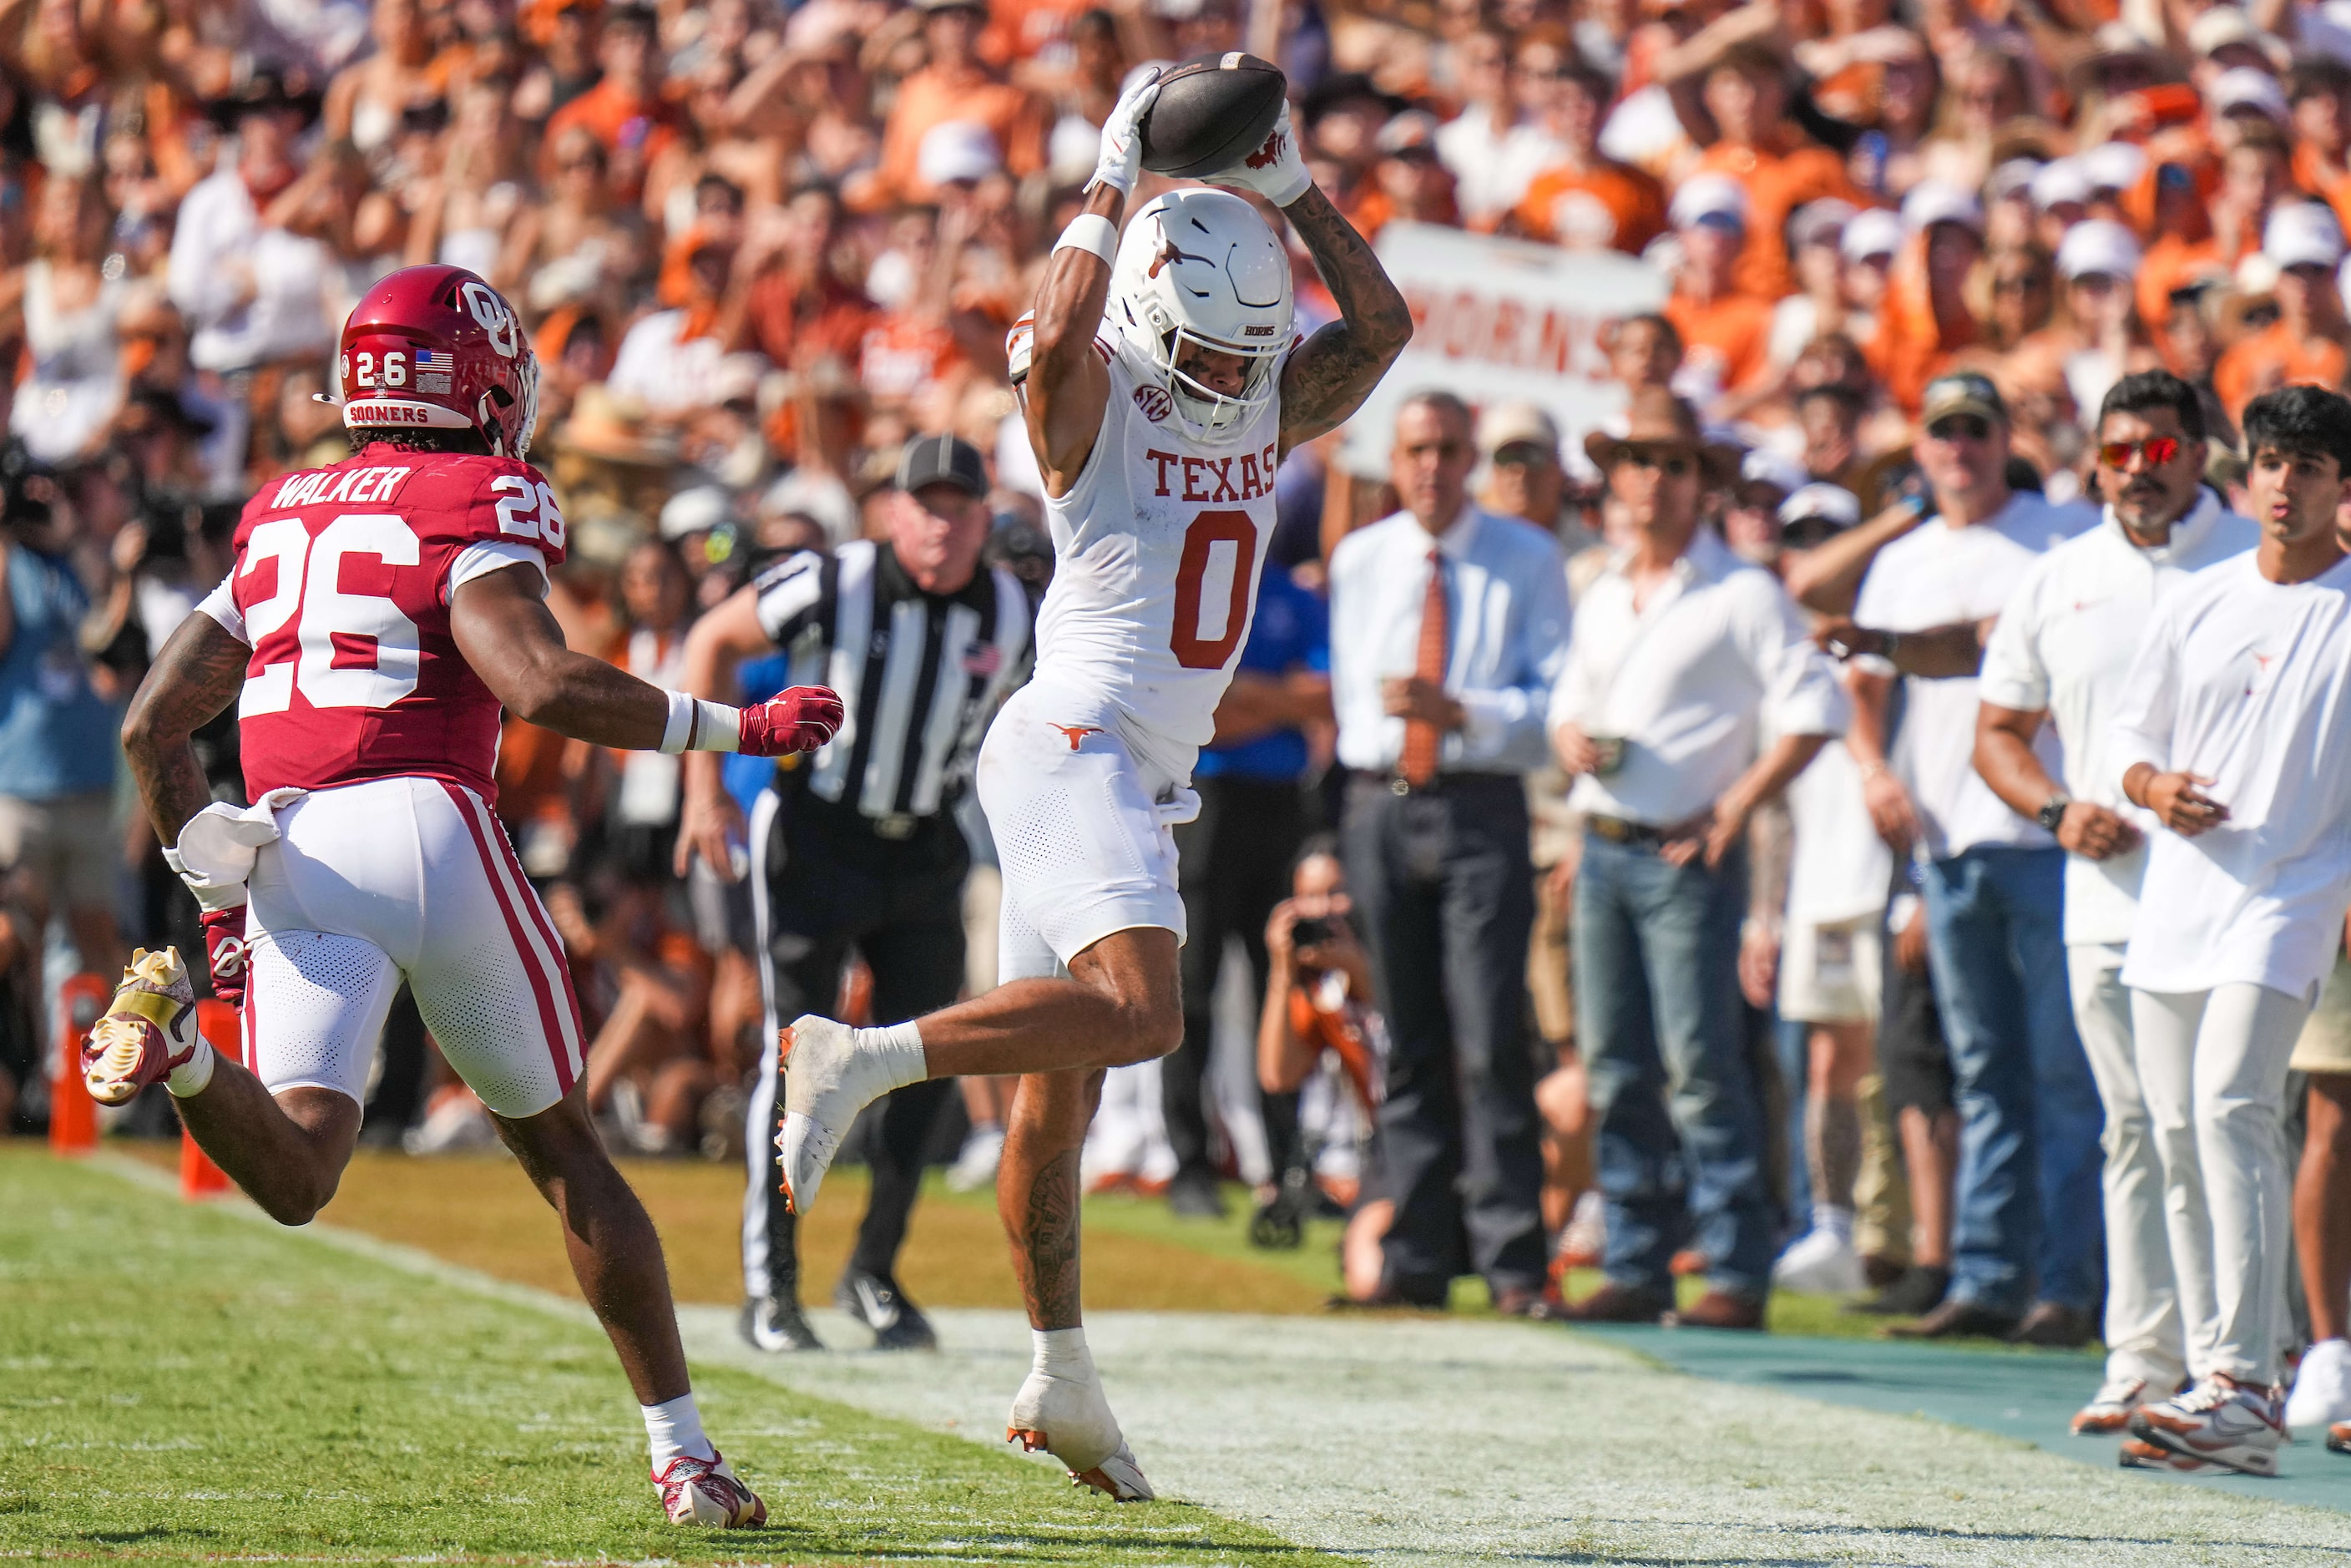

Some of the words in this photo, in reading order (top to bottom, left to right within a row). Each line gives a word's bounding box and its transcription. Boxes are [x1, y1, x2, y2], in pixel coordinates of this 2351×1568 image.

[462, 281, 519, 359] OU
[1245, 326, 1275, 336] HORNS
[356, 352, 407, 387] 26
[350, 406, 428, 423] SOONERS
[1135, 387, 1170, 422] SEC
[270, 466, 411, 509] WALKER
[1146, 442, 1276, 503] TEXAS
[491, 475, 566, 550] 26
[1170, 510, 1258, 670] 0
[238, 513, 420, 721] 26
